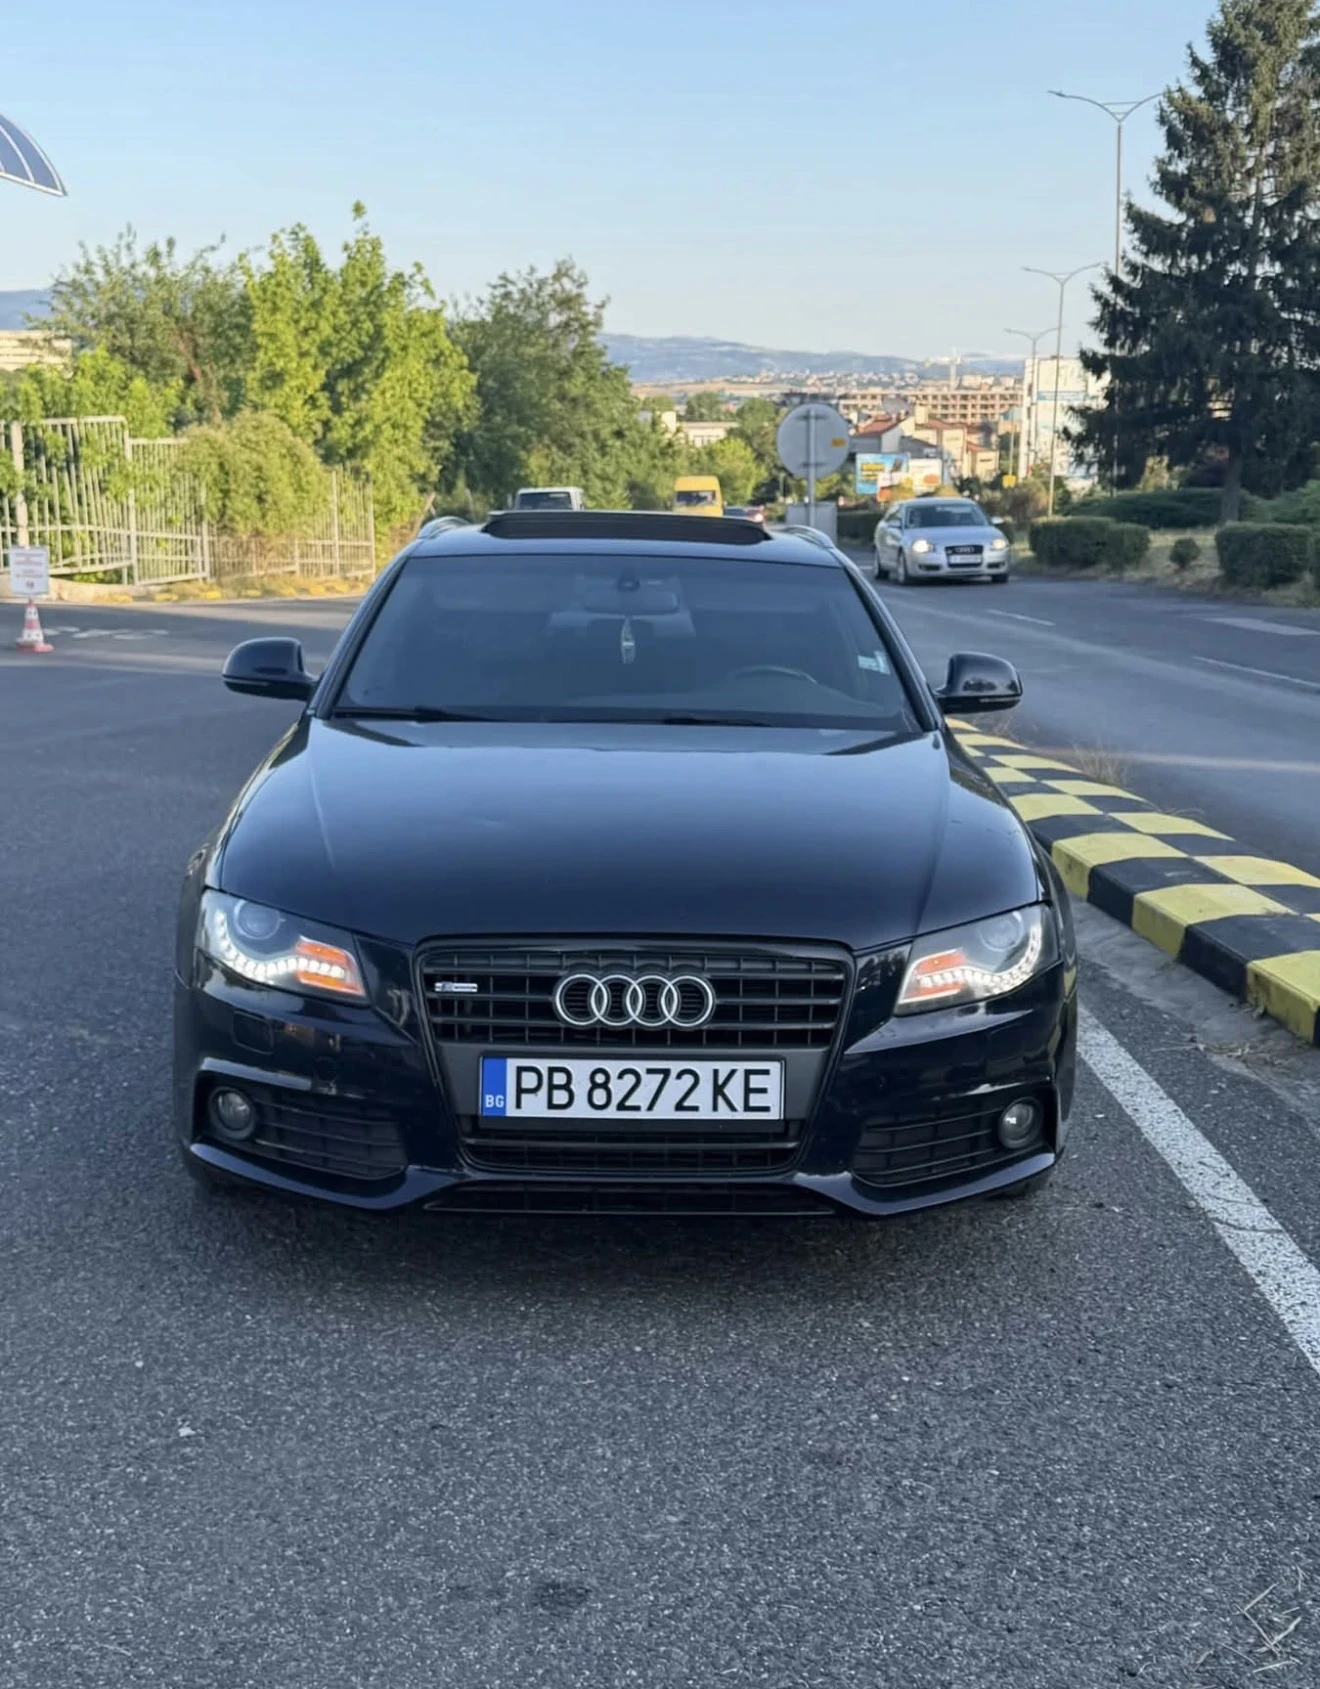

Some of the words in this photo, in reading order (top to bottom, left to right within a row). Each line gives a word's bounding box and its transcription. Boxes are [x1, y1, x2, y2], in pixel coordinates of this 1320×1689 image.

[485, 1095, 505, 1108] BG
[515, 1065, 575, 1110] PB
[587, 1067, 700, 1112] 8272
[712, 1068, 771, 1113] KE
